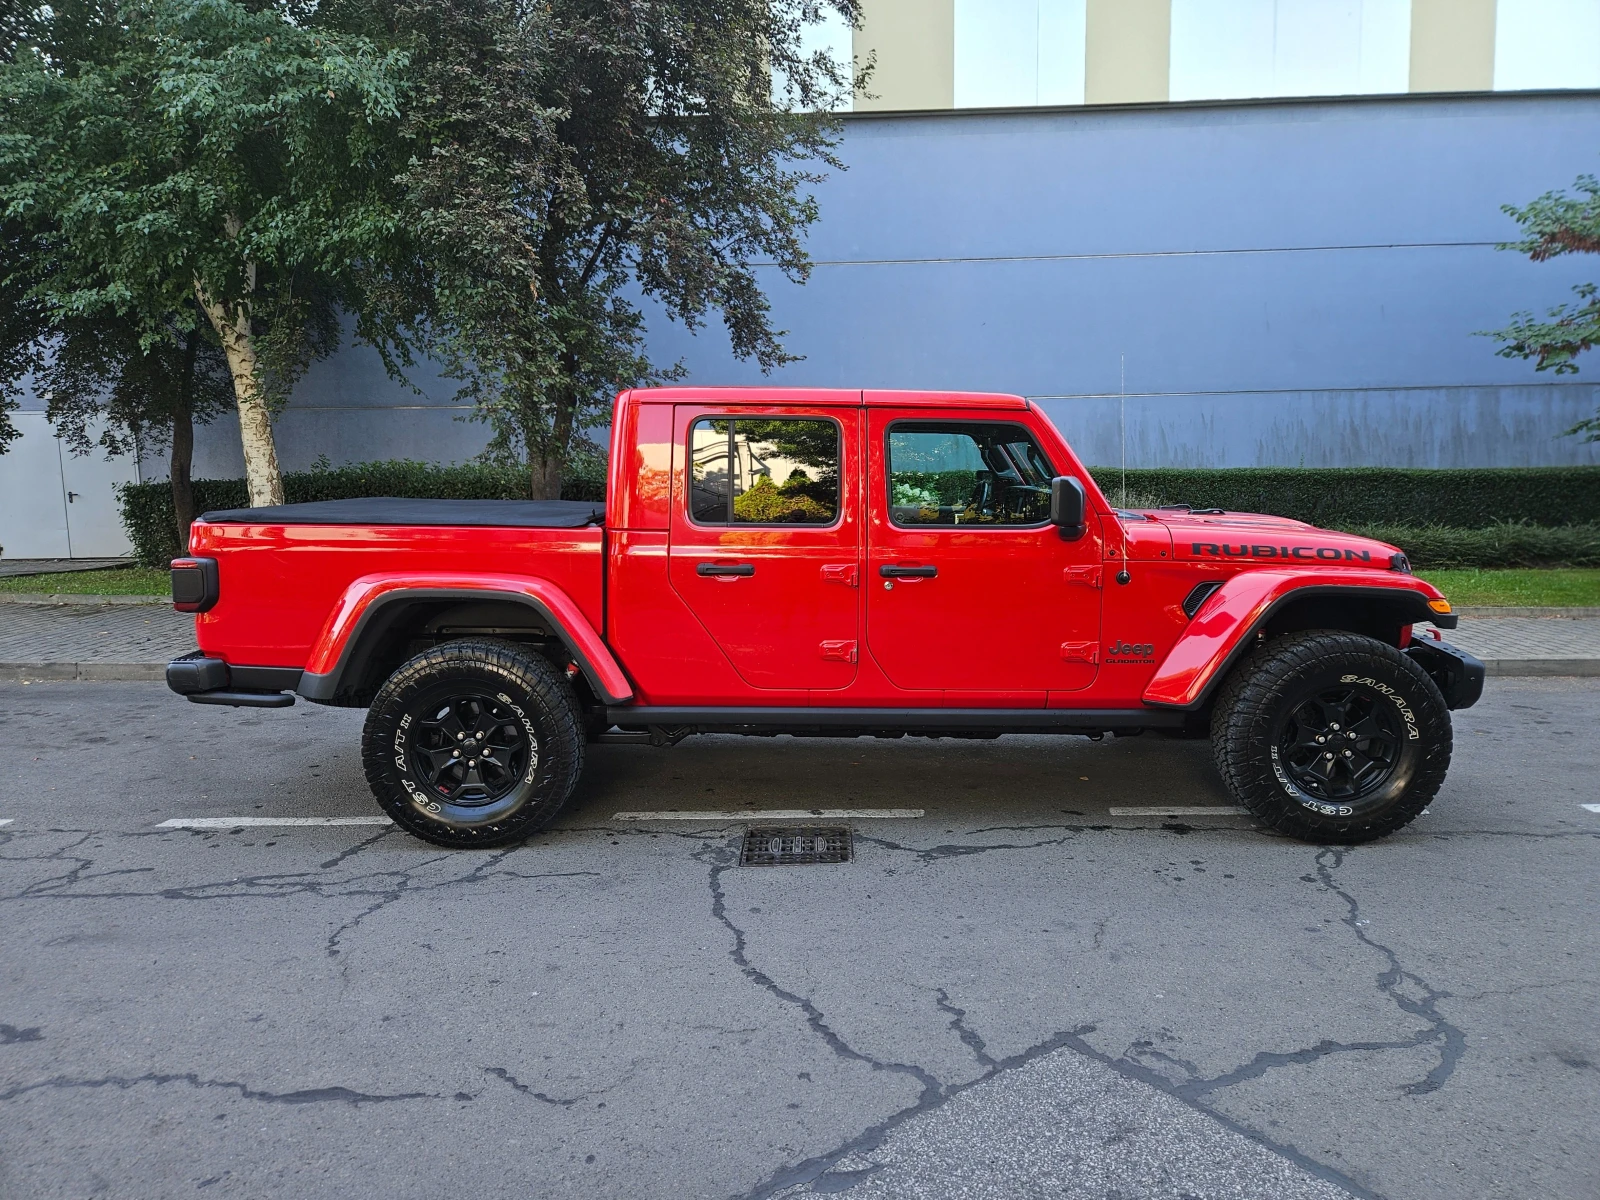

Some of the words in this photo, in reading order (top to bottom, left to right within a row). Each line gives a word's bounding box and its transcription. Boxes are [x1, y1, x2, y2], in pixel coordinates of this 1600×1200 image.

[1191, 542, 1371, 562] RUBICON
[1108, 639, 1155, 658] Jeep
[1339, 674, 1420, 740] SAHARA
[496, 692, 539, 784] SAHARA
[401, 779, 442, 813] CST
[1303, 800, 1353, 816] CST
